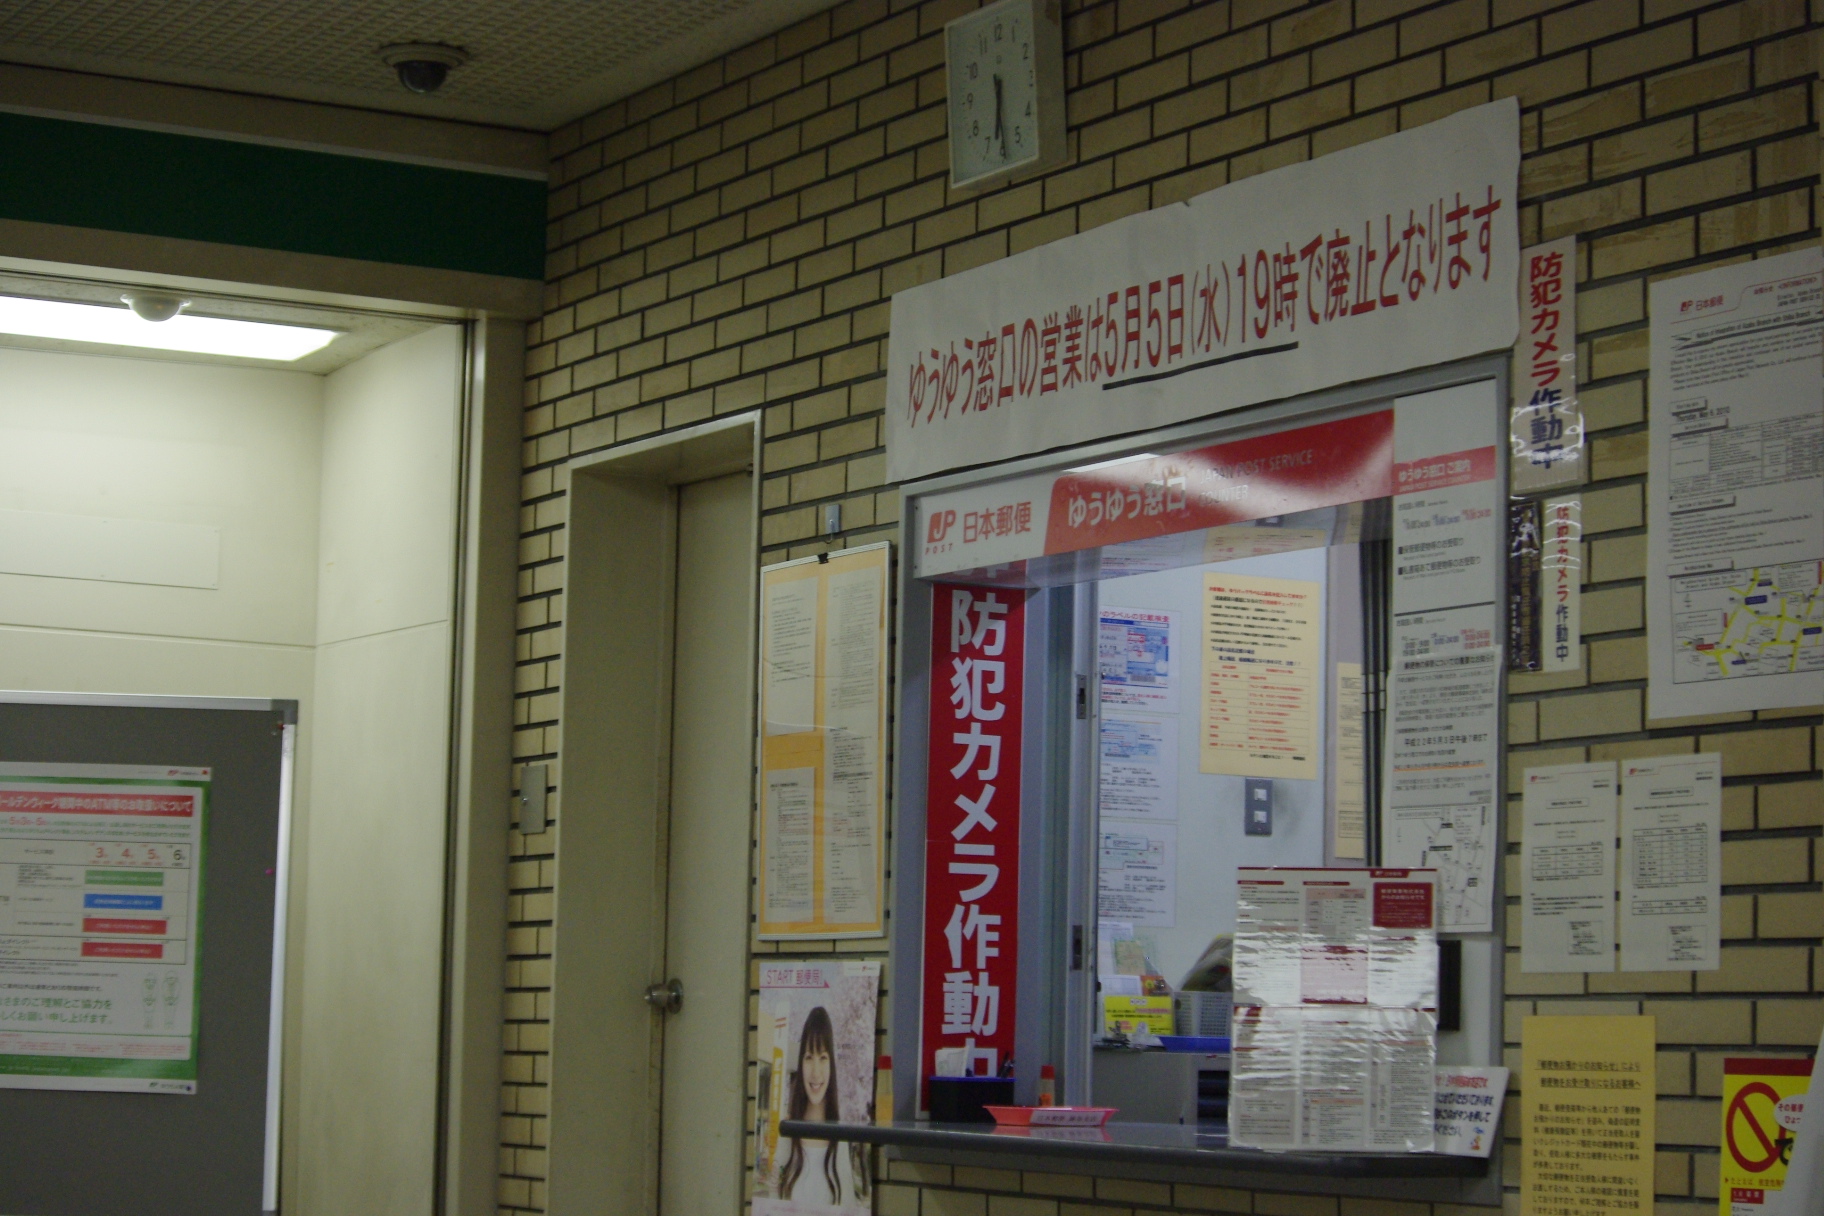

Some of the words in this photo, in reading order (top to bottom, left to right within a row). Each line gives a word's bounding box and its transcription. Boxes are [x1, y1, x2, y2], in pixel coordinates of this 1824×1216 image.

[1022, 43, 1029, 60] 2
[1025, 101, 1031, 117] 4
[972, 120, 979, 136] 8
[1014, 126, 1021, 143] 5
[1530, 252, 1563, 469] 防犯カメラ作動中
[1200, 463, 1234, 486] JAPAN
[1236, 458, 1266, 478] POST
[1268, 448, 1313, 472] SERVICE
[1200, 484, 1249, 507] COUNTER
[962, 500, 1031, 545] 日本郵便
[1067, 477, 1188, 529] ゆうゆう窓口
[925, 543, 954, 555] POST
[1556, 506, 1569, 662] 防犯カメラ作動中
[1100, 610, 1169, 623] のラベルの記載検査
[766, 969, 793, 985] START
